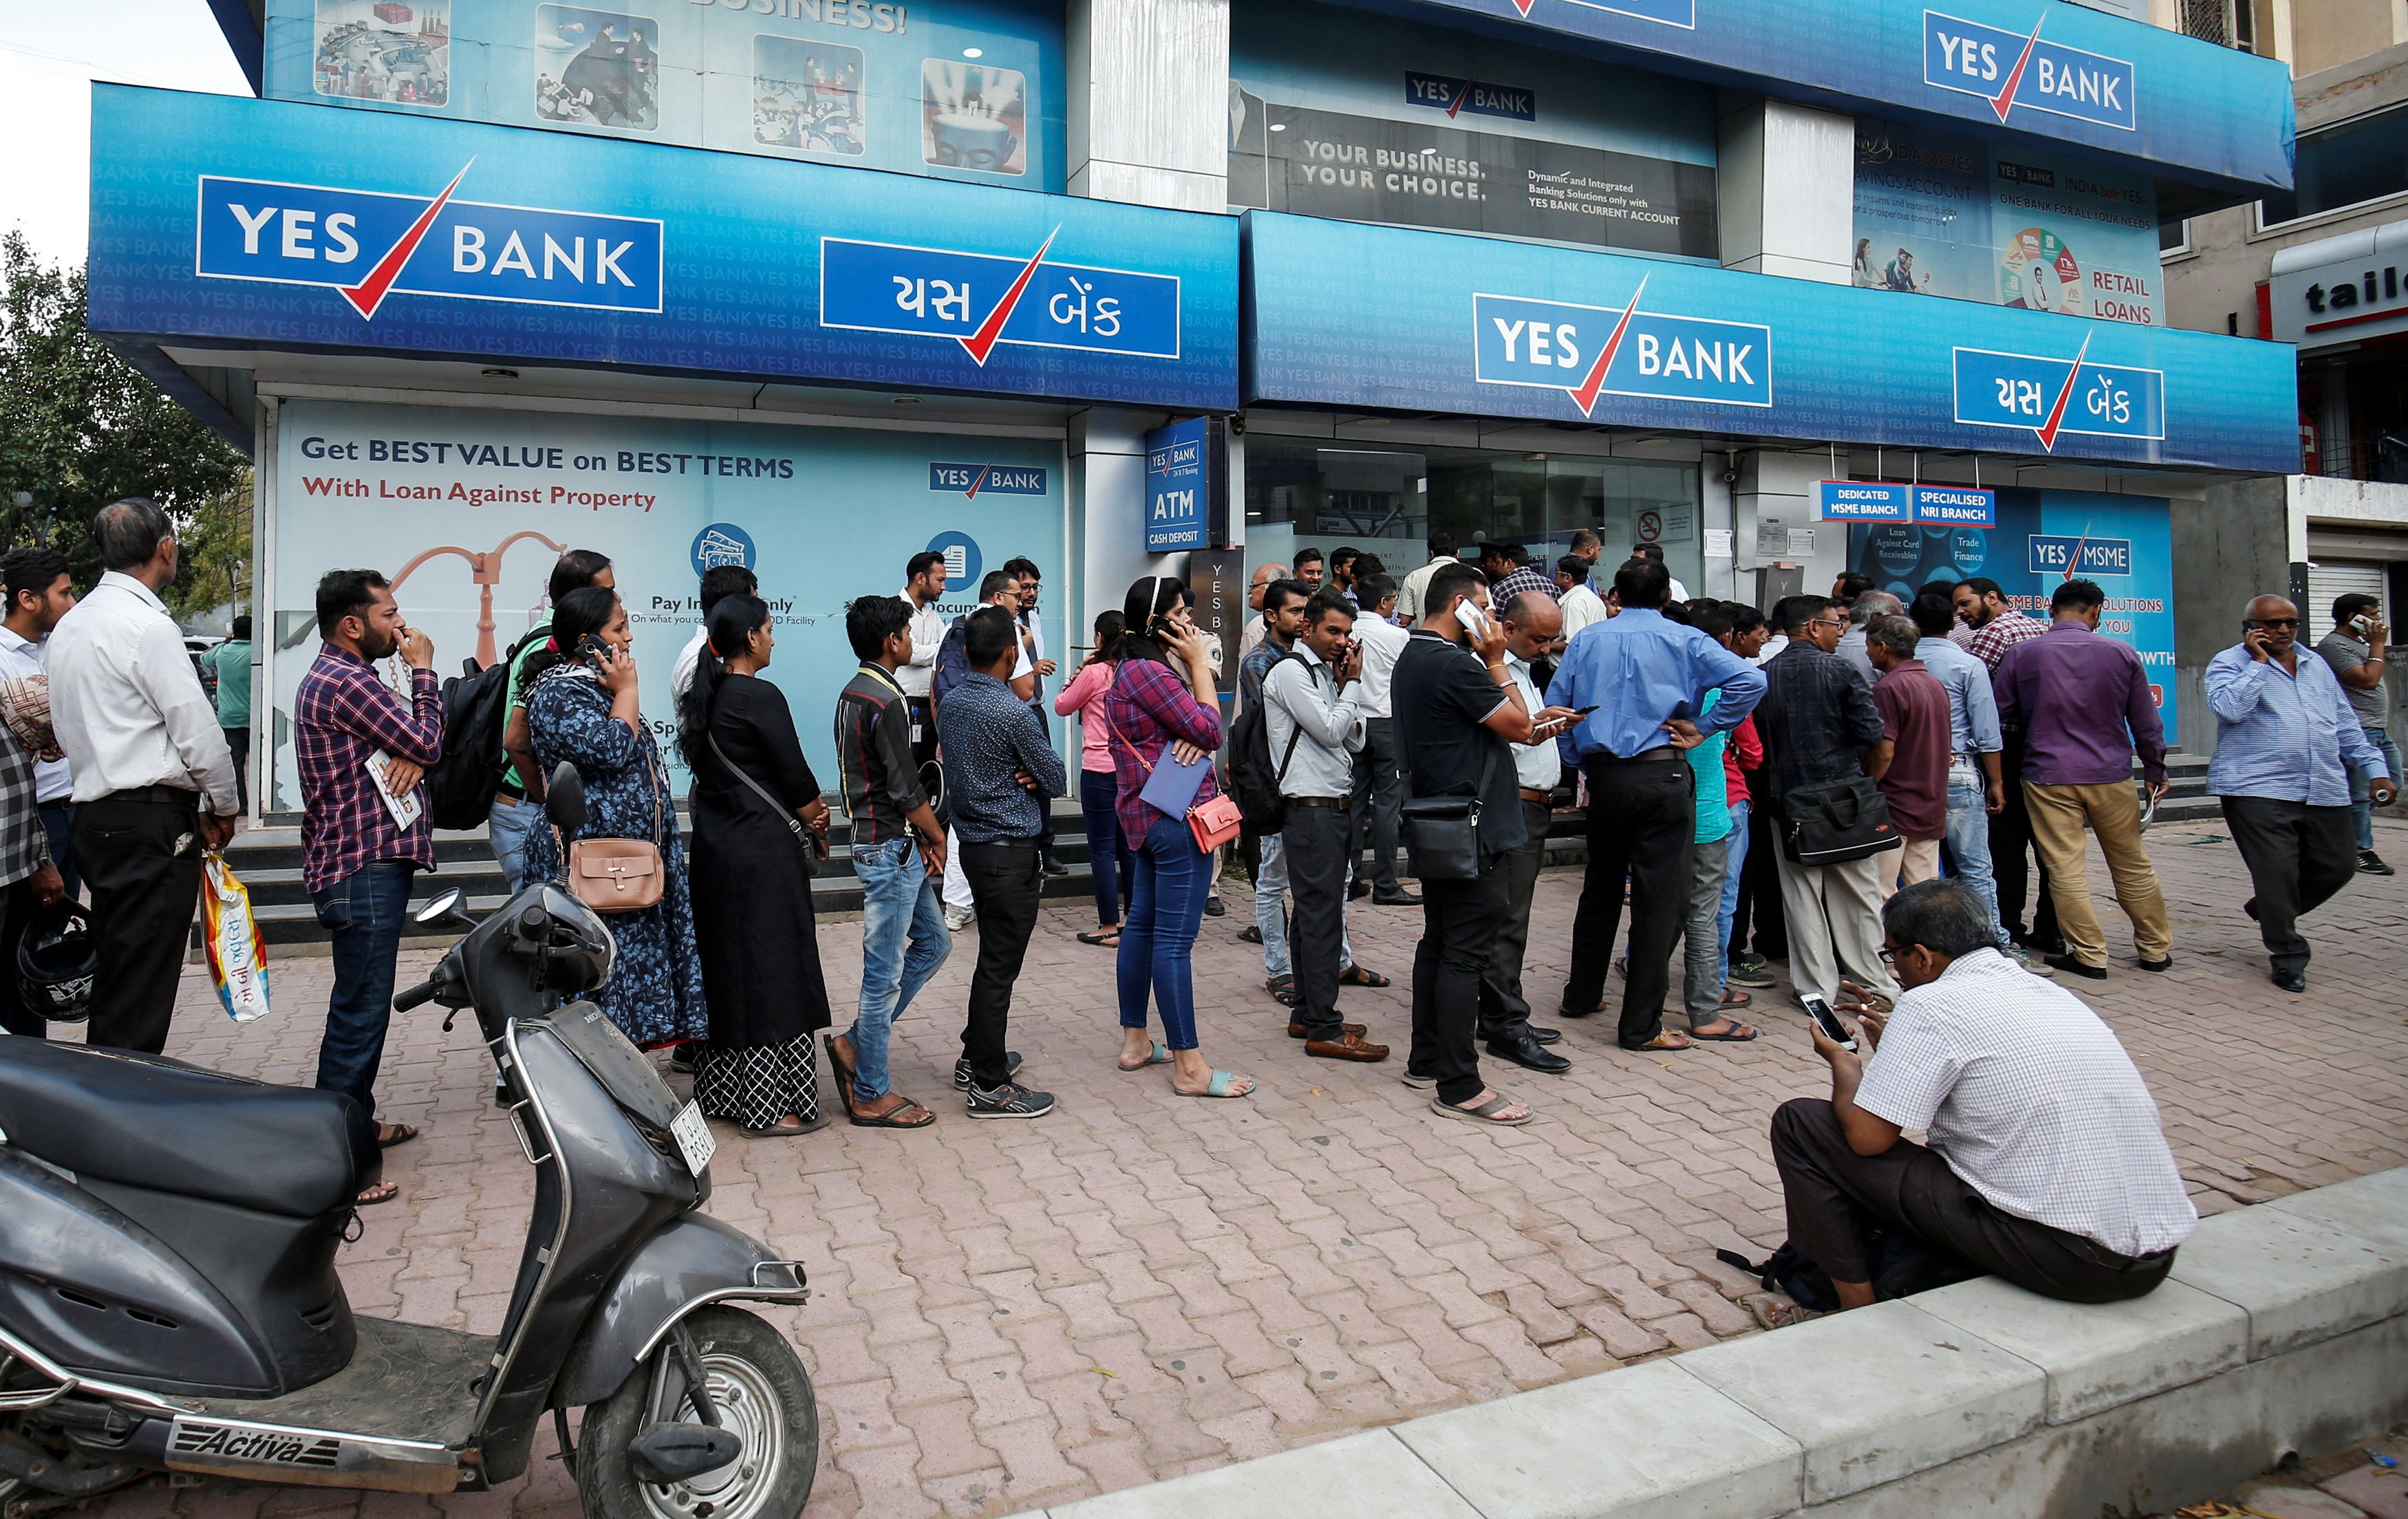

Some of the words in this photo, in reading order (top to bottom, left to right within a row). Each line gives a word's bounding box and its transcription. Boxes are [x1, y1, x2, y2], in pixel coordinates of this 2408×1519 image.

[691, 0, 907, 34] SINESS!
[1936, 32, 1998, 81] YES
[2038, 57, 2124, 111] BANK
[1412, 79, 1449, 103] YES
[1474, 89, 1528, 114] BANK
[1304, 140, 1369, 164] YOUR
[1376, 149, 1486, 180] BUSINESS.
[1302, 164, 1375, 190] YOUR
[1386, 173, 1487, 202] CHOICE.
[1528, 170, 1568, 184] Dynamic
[1570, 175, 1586, 187] and
[1588, 177, 1633, 193] Integrated
[1854, 169, 1902, 189] AVINGS
[1904, 177, 1972, 201] ACCOUNT
[2000, 165, 2017, 177] YES
[2028, 170, 2052, 184] BANK
[1528, 184, 1563, 199] Banking
[1567, 189, 1607, 204] Solutions
[1609, 196, 1628, 208] only
[1631, 198, 1648, 208] with
[2065, 177, 2098, 195] INDIA
[1529, 197, 1548, 208] YES
[1550, 200, 1579, 213] BANK
[1581, 204, 1628, 219] CURRENT
[1630, 211, 1680, 226] ACCOUNT
[1864, 195, 1889, 205] returns
[1892, 199, 1904, 208] and
[1906, 200, 1928, 211] instant
[2000, 194, 2021, 206] ONE
[2025, 198, 2051, 212] BANK
[2054, 204, 2073, 215] FOR
[2075, 208, 2092, 219] ALL
[2094, 211, 2118, 224] YOUR
[2121, 217, 2150, 230] NEEDS
[1869, 208, 1909, 220] prosperous
[1911, 215, 1946, 226] tomorrow
[227, 203, 359, 263] YES
[453, 224, 636, 288] BANK
[2093, 271, 2149, 297] RETAIL
[2306, 267, 2408, 313] tail
[892, 275, 970, 322] યસ
[1049, 276, 1123, 337] બેંક
[2094, 299, 2151, 324] LOANS
[1493, 317, 1580, 369] YES
[1638, 333, 1754, 385] BANK
[1995, 378, 2042, 416] યસ
[2087, 374, 2130, 424] બેંક
[301, 437, 358, 461] Get
[369, 440, 452, 464] BEST
[458, 444, 563, 469] VALUE
[573, 455, 607, 471] on
[617, 451, 691, 475] BEST
[702, 455, 794, 480] TERMS
[1152, 455, 1165, 467] YES
[1174, 446, 1196, 463] BANK
[936, 468, 969, 486] YES
[991, 472, 1040, 490] BANK
[1173, 469, 1178, 477] 24
[301, 476, 369, 498] With
[379, 480, 442, 501] Loan
[448, 482, 542, 507] Against
[550, 486, 656, 512] Property
[1838, 490, 1889, 500] DEDICATED
[1921, 492, 1986, 506] SPECIALISED
[1153, 489, 1194, 521] ATM
[1831, 504, 1858, 514] MSME
[1860, 505, 1898, 515] BRANCH
[1921, 506, 1939, 518] NRI
[1942, 508, 1986, 520] BRANCH
[1150, 532, 1168, 544] CASH
[1169, 530, 1198, 543] DEPOSIT
[1889, 528, 1906, 537] Loan
[1957, 537, 1979, 548] Trade
[1877, 539, 1901, 549] Against
[1903, 540, 1919, 549] Card
[1879, 550, 1917, 560] Receivables
[1955, 551, 1983, 561] Finance
[2036, 544, 2066, 565] YES
[2084, 544, 2127, 568] MSME
[652, 596, 681, 614] Pay
[764, 598, 793, 614] nly
[2008, 596, 2032, 609] SME
[2103, 599, 2162, 612] OLUTIONS
[631, 614, 646, 623] On
[675, 616, 690, 626] you
[786, 616, 815, 627] Facility
[2105, 620, 2130, 633] YOU
[197, 1429, 303, 1463] Activa
